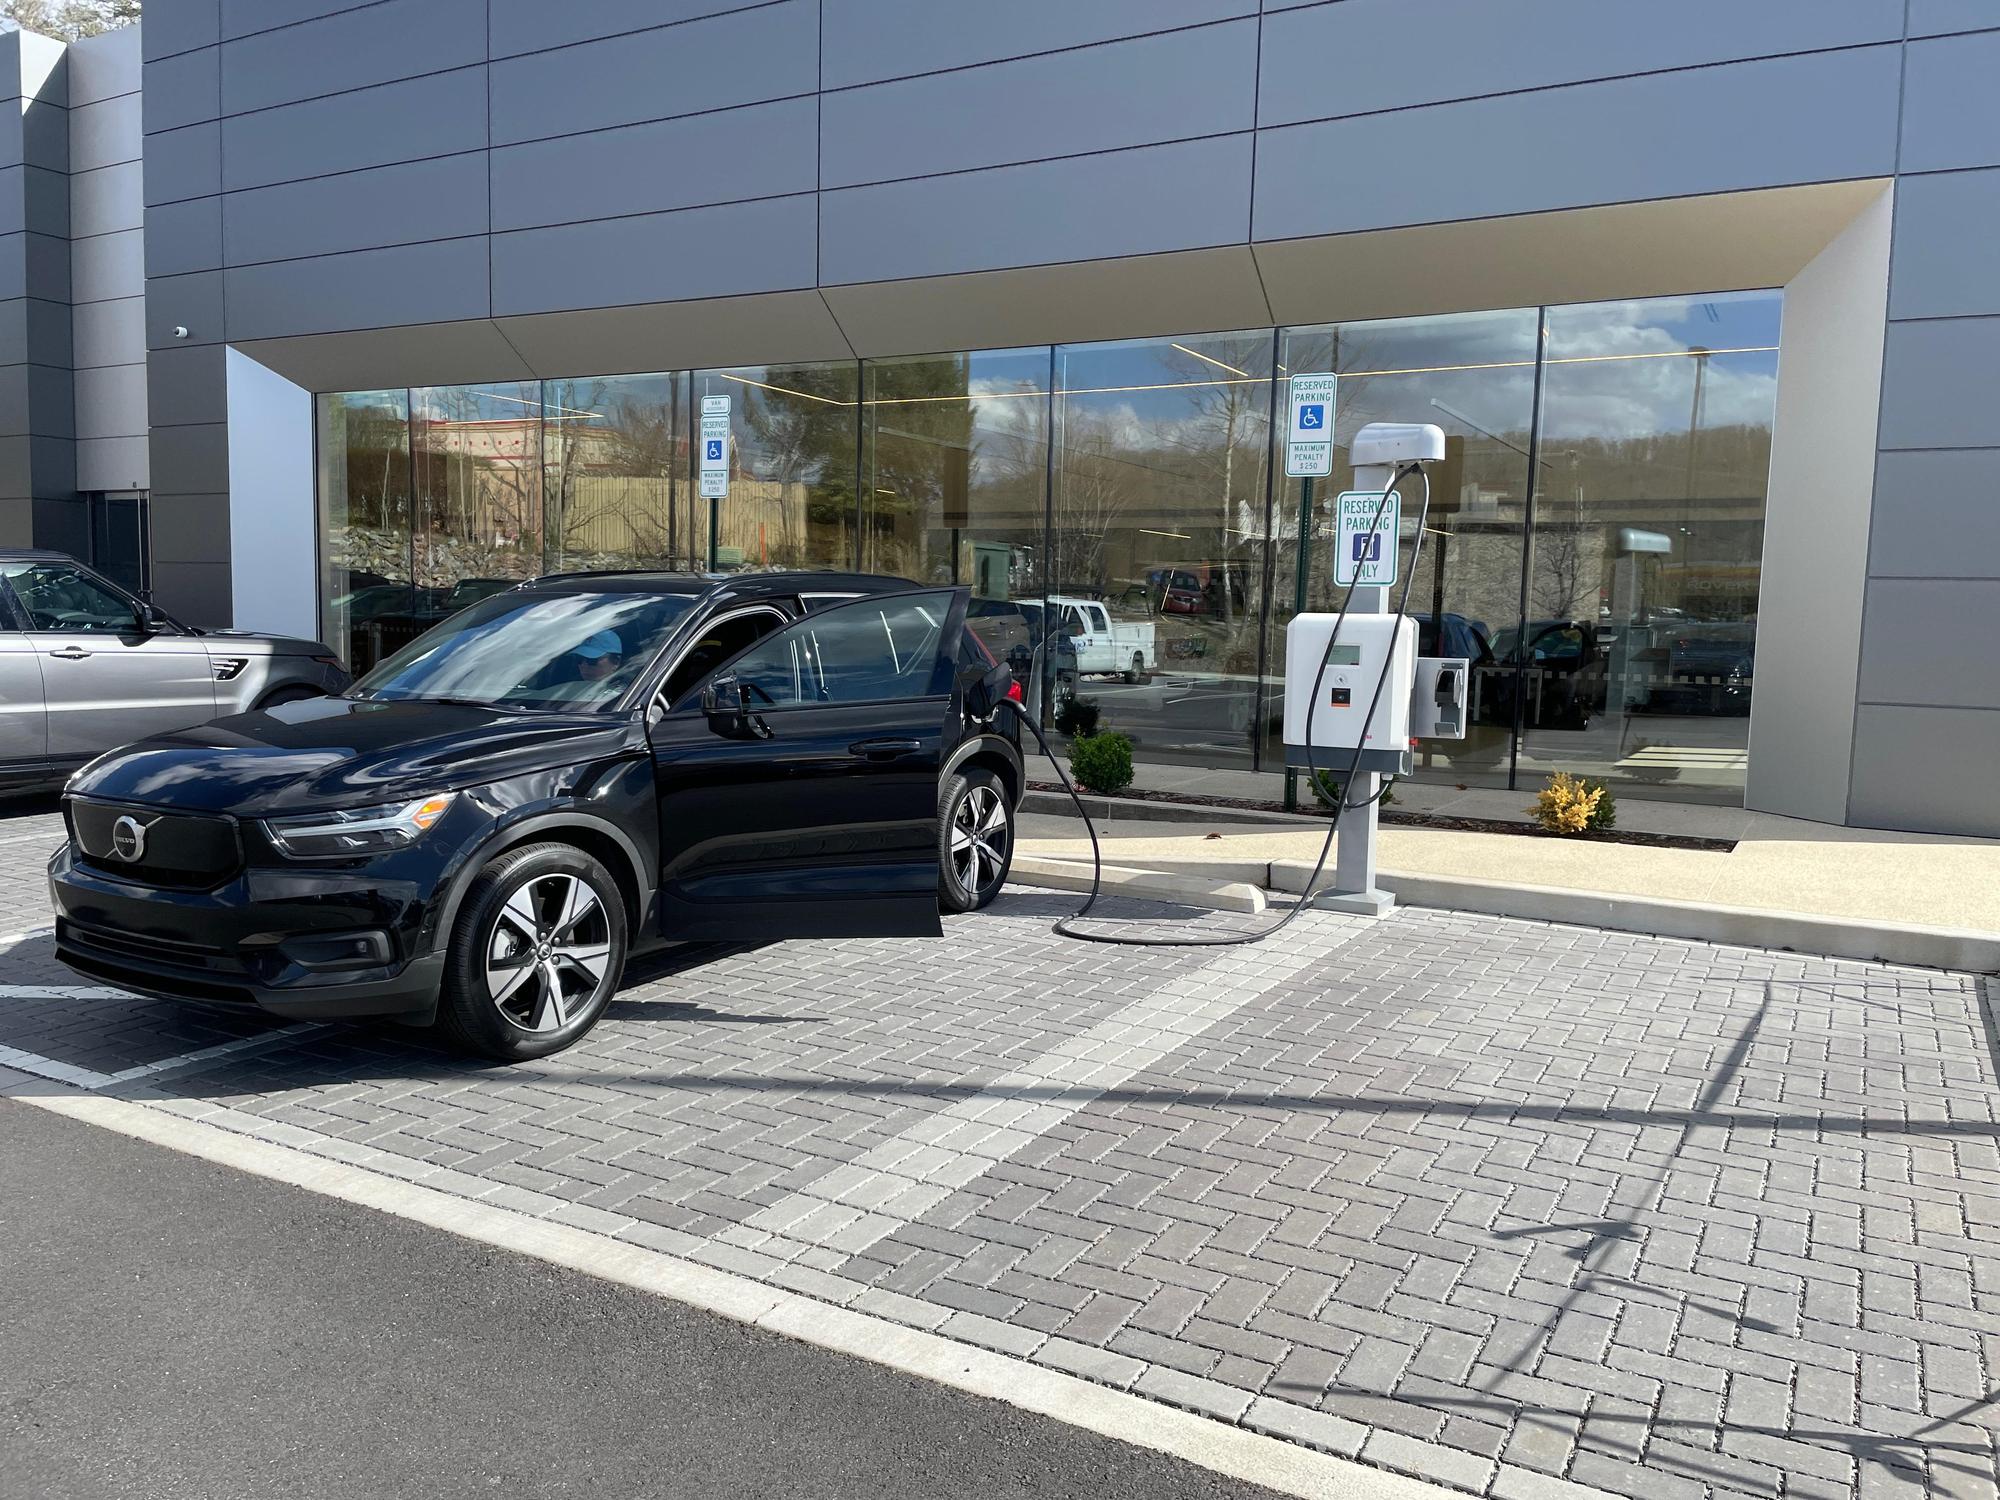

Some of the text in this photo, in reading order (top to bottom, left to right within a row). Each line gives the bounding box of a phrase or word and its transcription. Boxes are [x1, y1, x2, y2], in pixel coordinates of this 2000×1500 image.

[1293, 380, 1334, 391] RESERVED
[1294, 392, 1331, 402] PARKING
[703, 420, 728, 429] RESERVED
[704, 430, 727, 438] PARKING
[1294, 453, 1324, 461] PENALTY
[1300, 462, 1318, 470] $250
[1343, 500, 1393, 514] RESERVD
[1346, 516, 1390, 530] PARKNG
